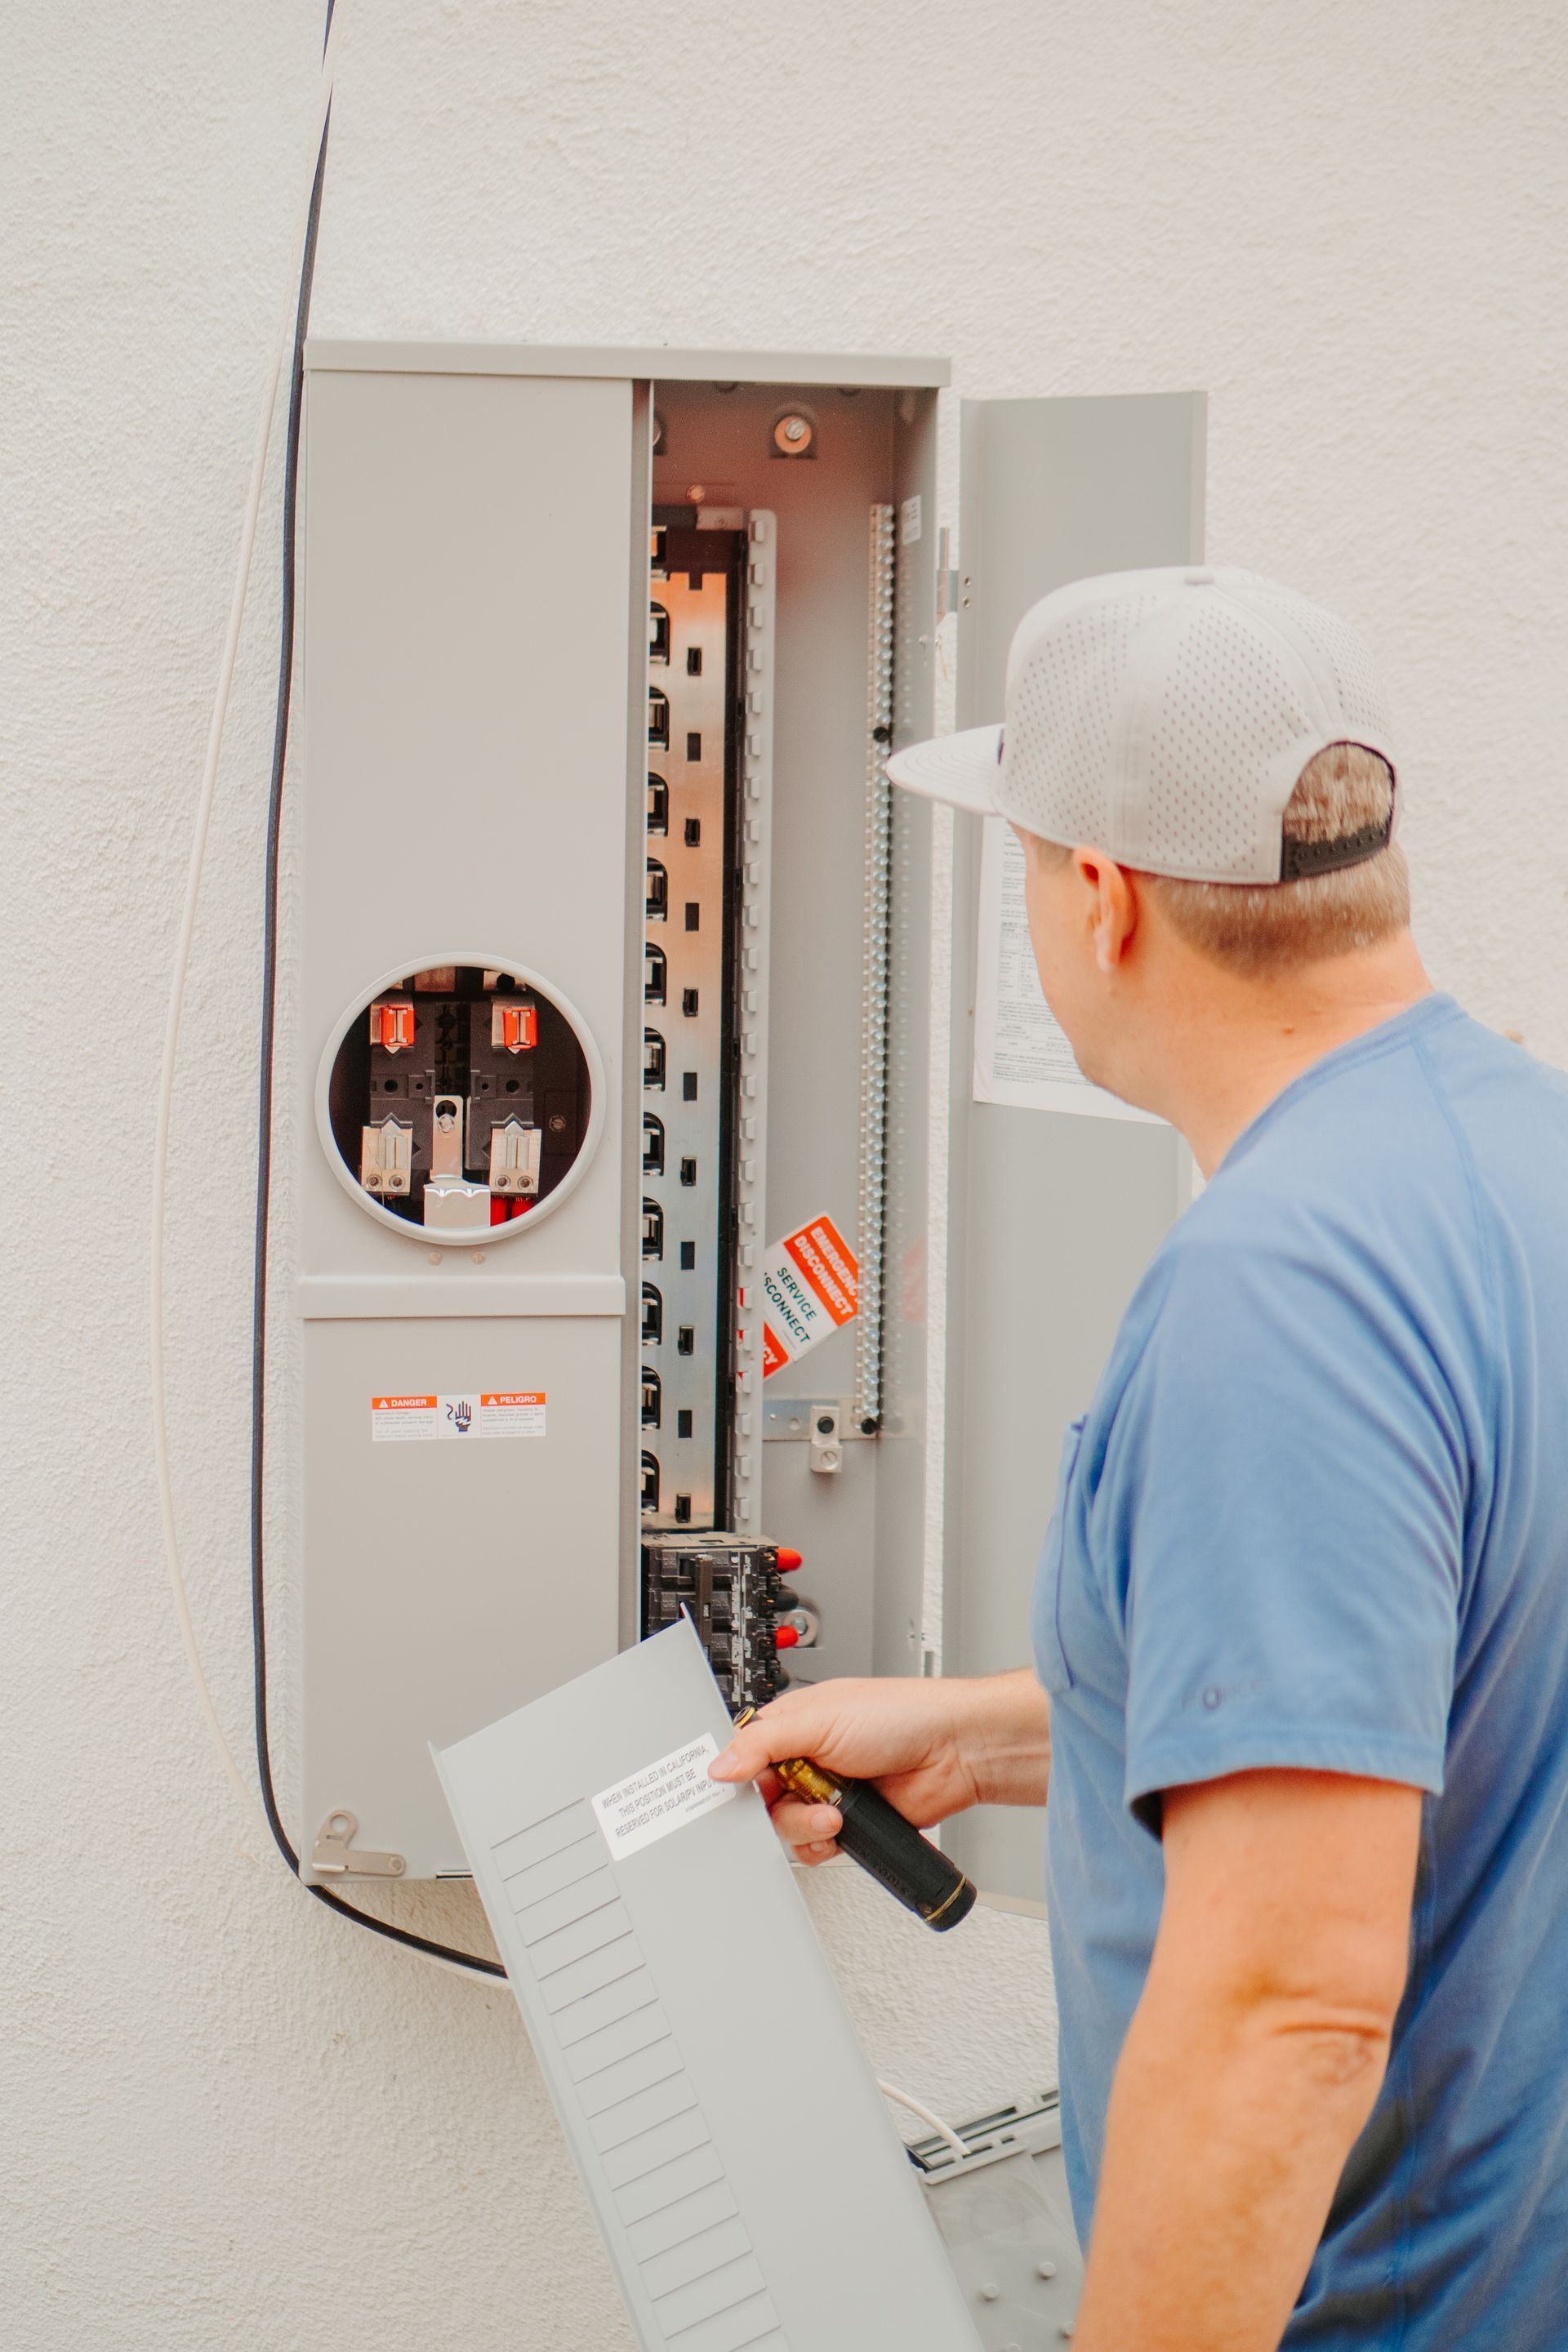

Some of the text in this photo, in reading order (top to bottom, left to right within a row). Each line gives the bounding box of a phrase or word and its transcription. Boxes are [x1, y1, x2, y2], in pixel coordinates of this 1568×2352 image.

[794, 1235, 853, 1315] DISCONNECT
[810, 1226, 862, 1304] EMERGENC
[777, 1267, 817, 1321] SERVICE
[391, 1398, 427, 1407] DANGER
[500, 1395, 537, 1404] PELIGRO
[601, 1791, 622, 1810] WHEN
[622, 1771, 659, 1798] INSTALLED
[659, 1767, 667, 1780] IN
[618, 1802, 635, 1818] THIS
[635, 1785, 666, 1808] POSITION
[666, 1775, 687, 1793] MUST
[685, 1768, 697, 1781] BE
[615, 1812, 650, 1838] RESERVED
[650, 1804, 664, 1821] FOR
